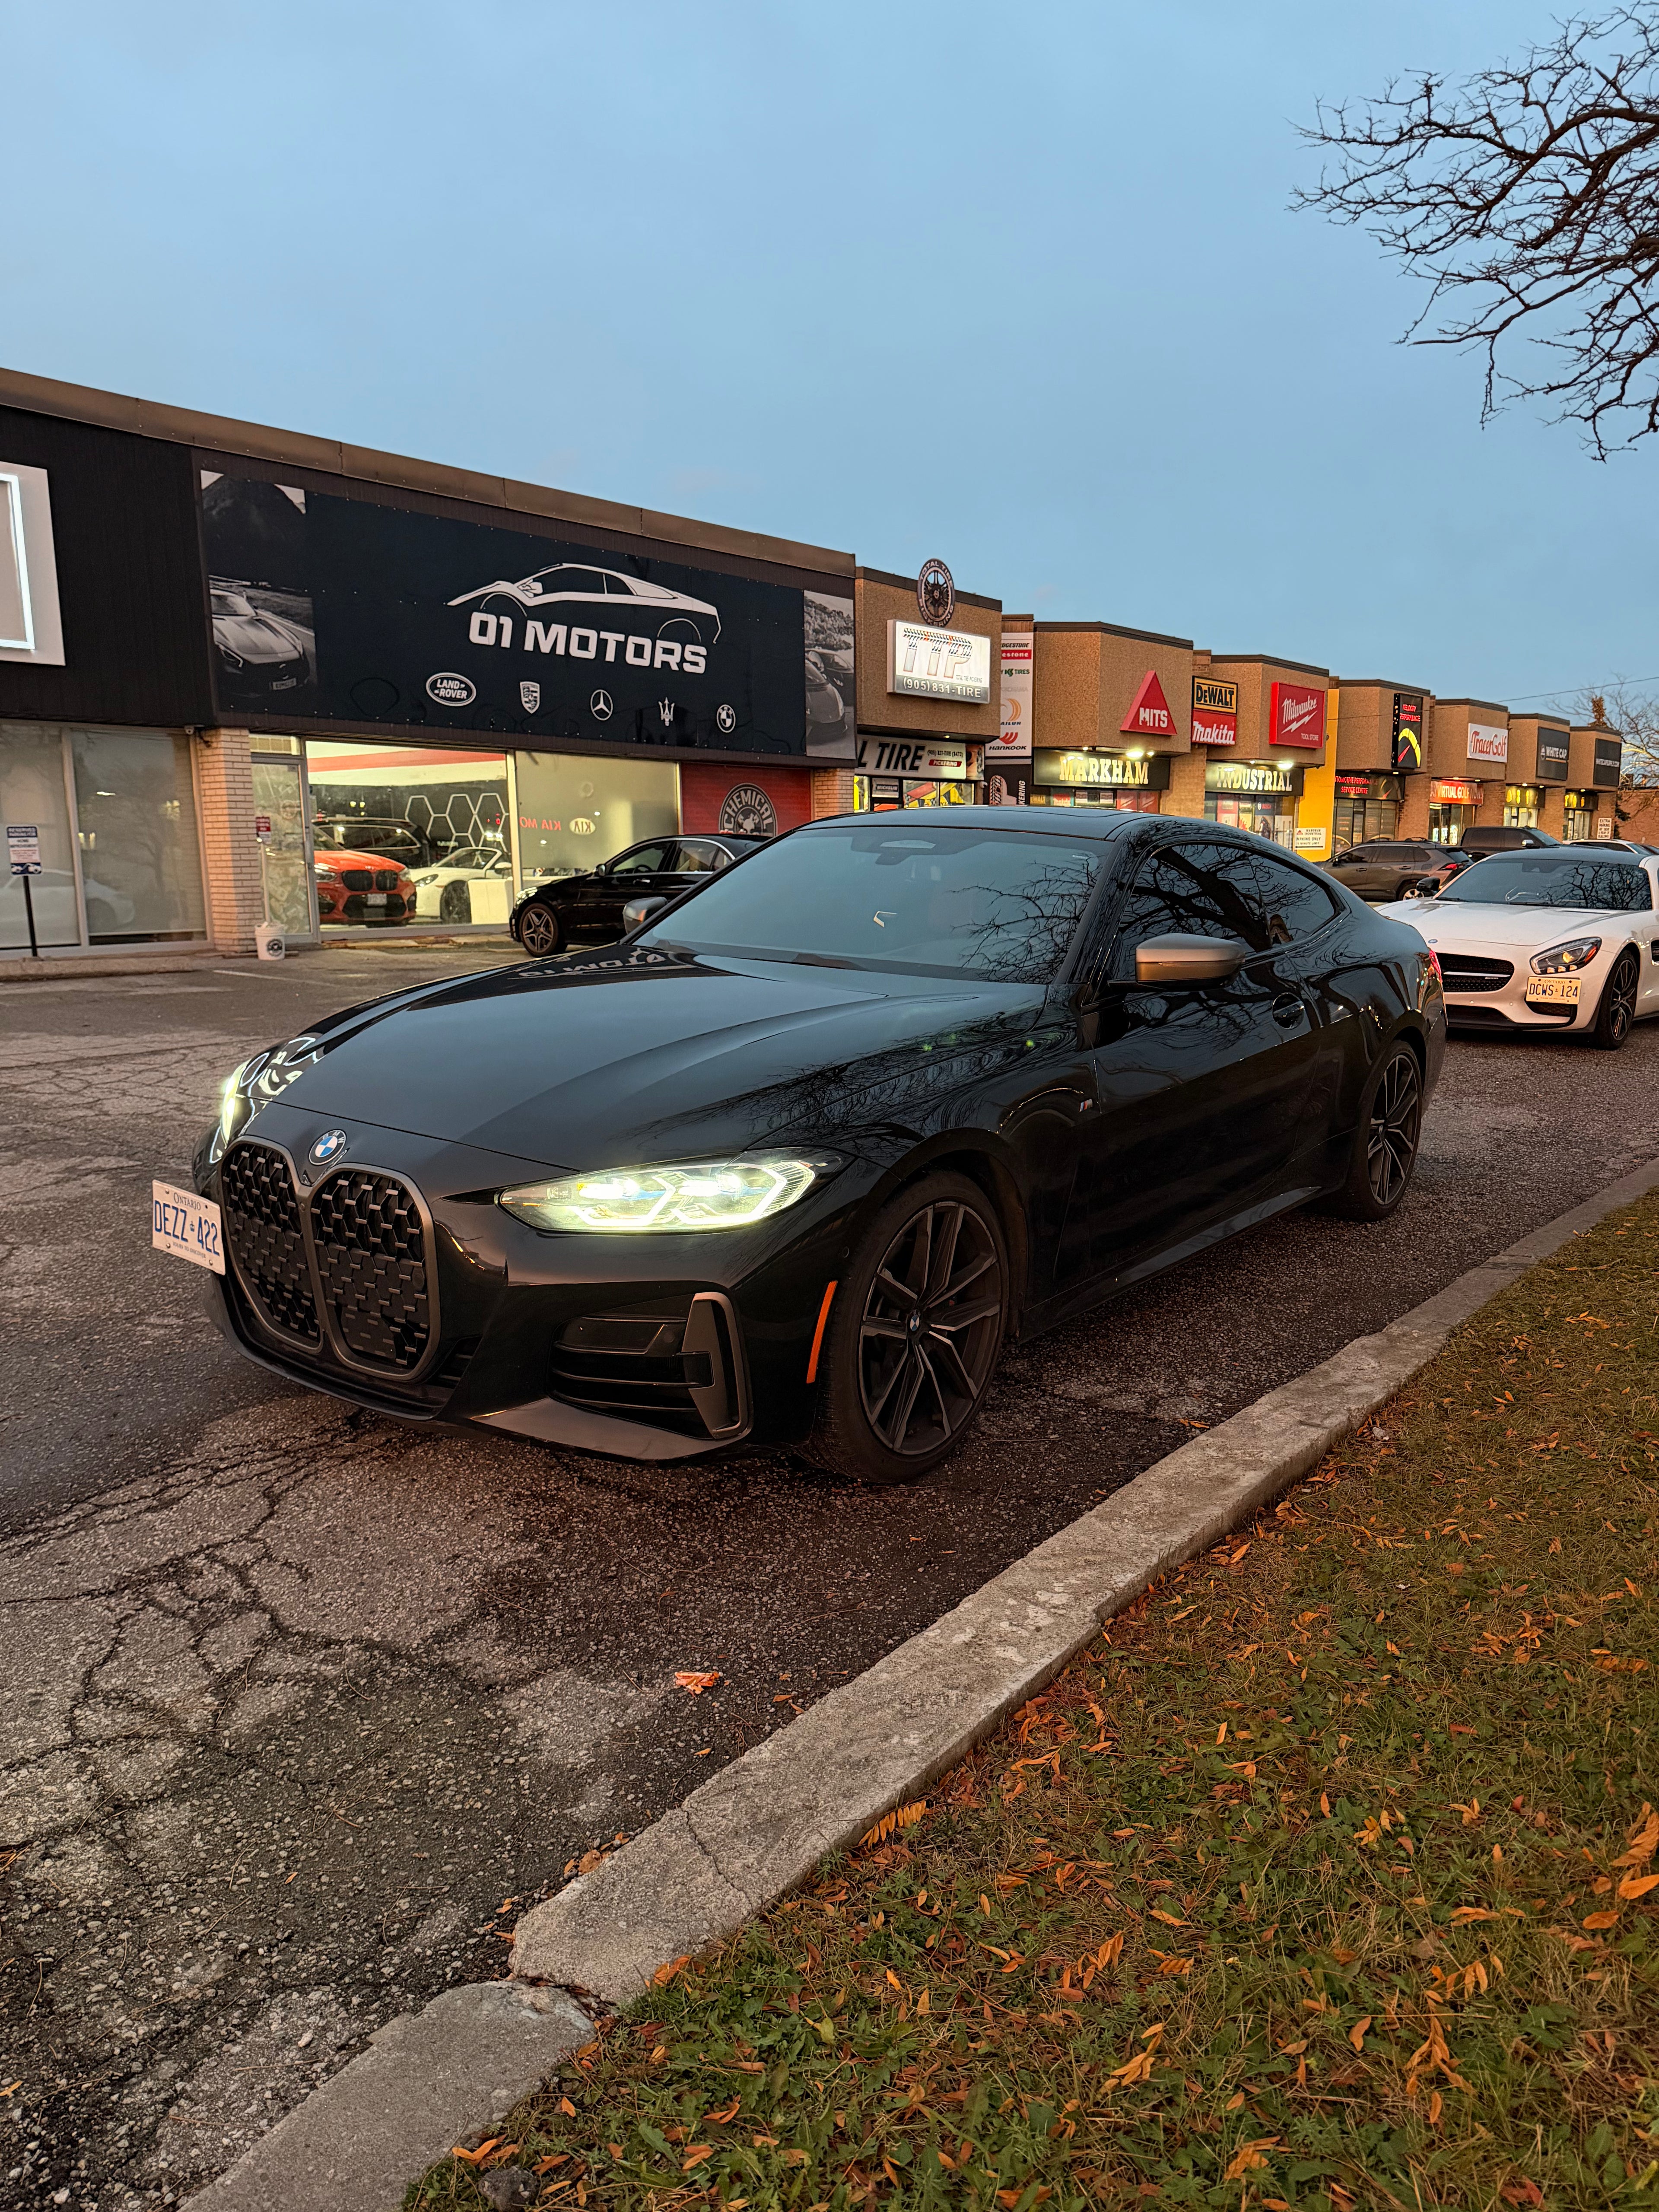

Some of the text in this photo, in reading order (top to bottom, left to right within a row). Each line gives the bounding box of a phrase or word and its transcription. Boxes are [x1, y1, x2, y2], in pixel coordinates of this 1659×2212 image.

[920, 561, 939, 580] TOTAL
[469, 611, 707, 674] 01 MOTORS
[436, 679, 460, 690] LAND
[439, 688, 467, 699] ROVER
[1196, 684, 1234, 706] DEWALT
[1139, 707, 1168, 728] MITS
[1281, 695, 1317, 725] Milwaukee
[875, 742, 925, 771] TIRE
[1546, 746, 1567, 759] WHITE CAP
[1059, 756, 1149, 785] MARKHAM
[1217, 767, 1292, 791] INDUSTRIAL
[1437, 785, 1457, 798] VIRTUAL
[1457, 787, 1469, 799] GOLF
[724, 790, 773, 830] CHEMICAL
[1529, 983, 1578, 998] DCWS 124
[174, 1192, 201, 1211] ONTARIO
[154, 1200, 220, 1257] DEZZ 422
